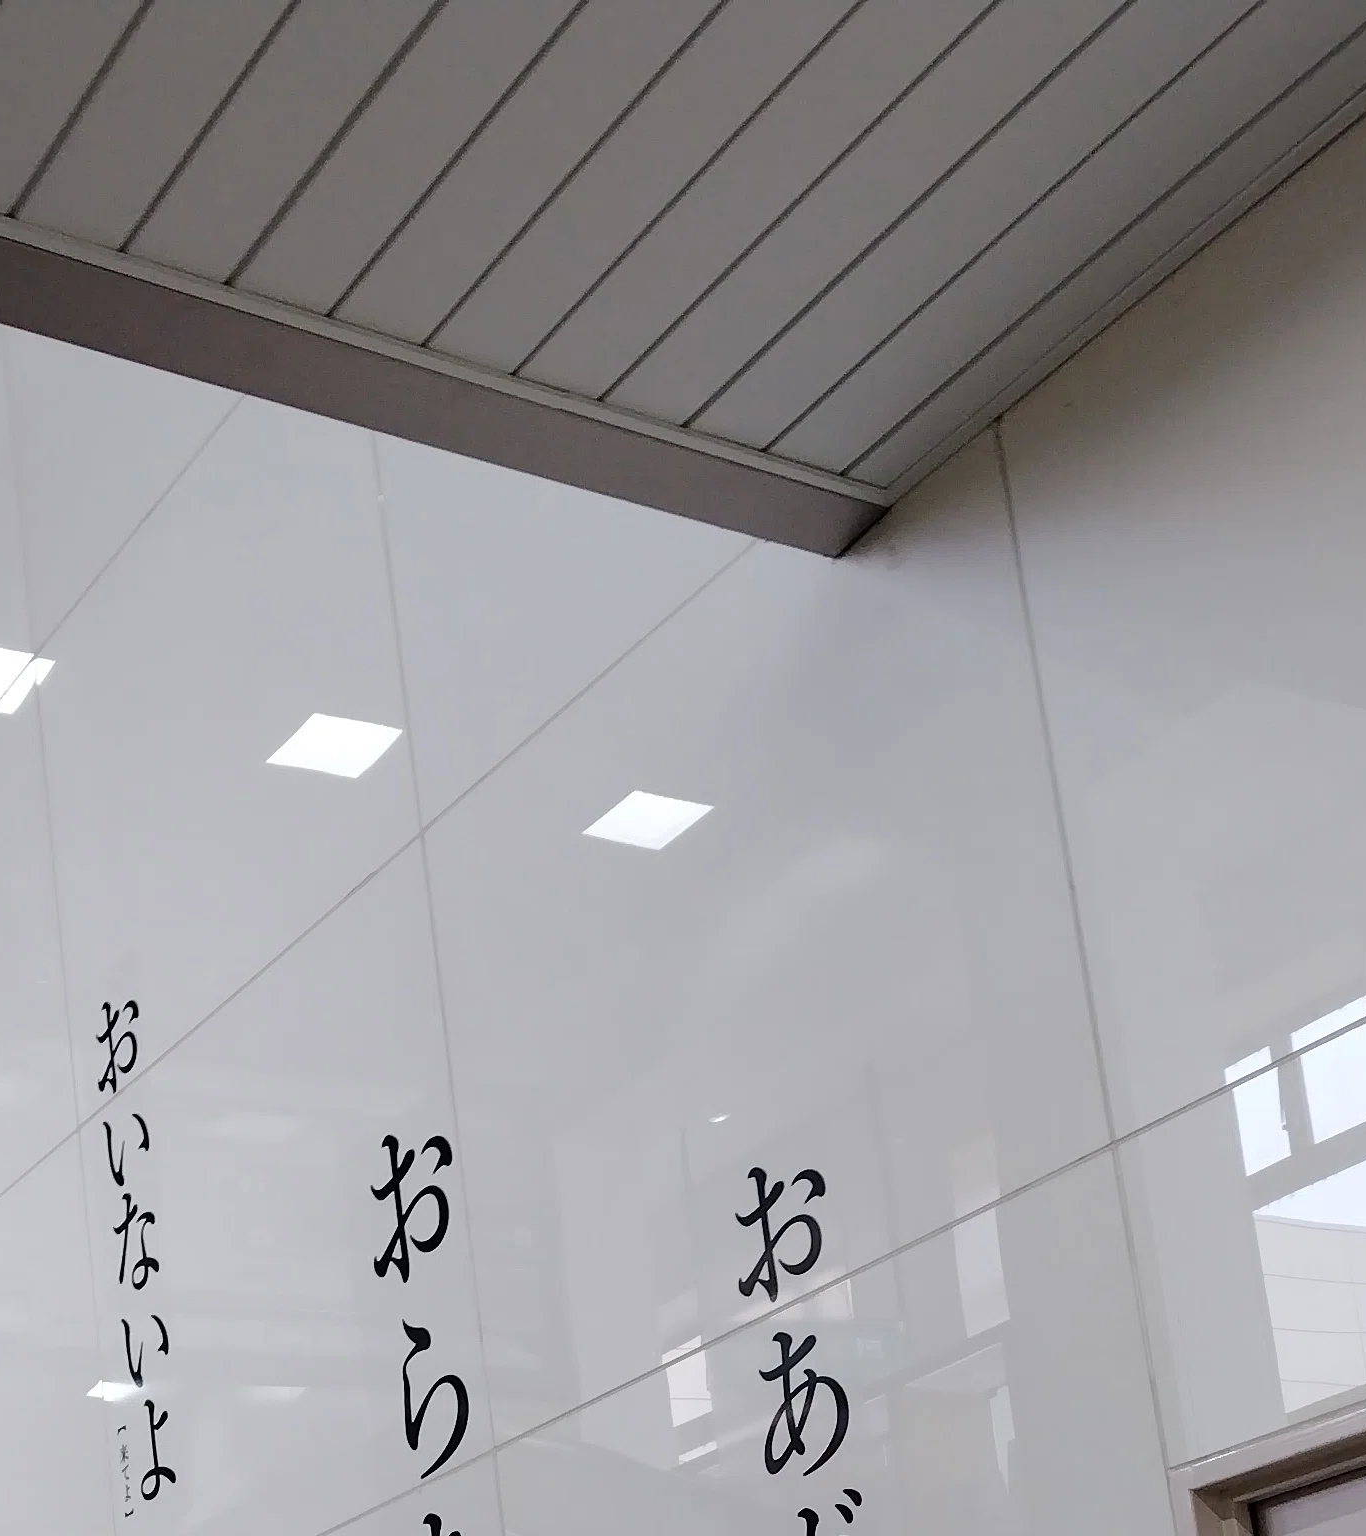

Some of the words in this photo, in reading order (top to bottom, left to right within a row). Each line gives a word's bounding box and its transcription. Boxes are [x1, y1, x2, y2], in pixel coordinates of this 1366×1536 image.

[95, 999, 177, 1501] おいないよ
